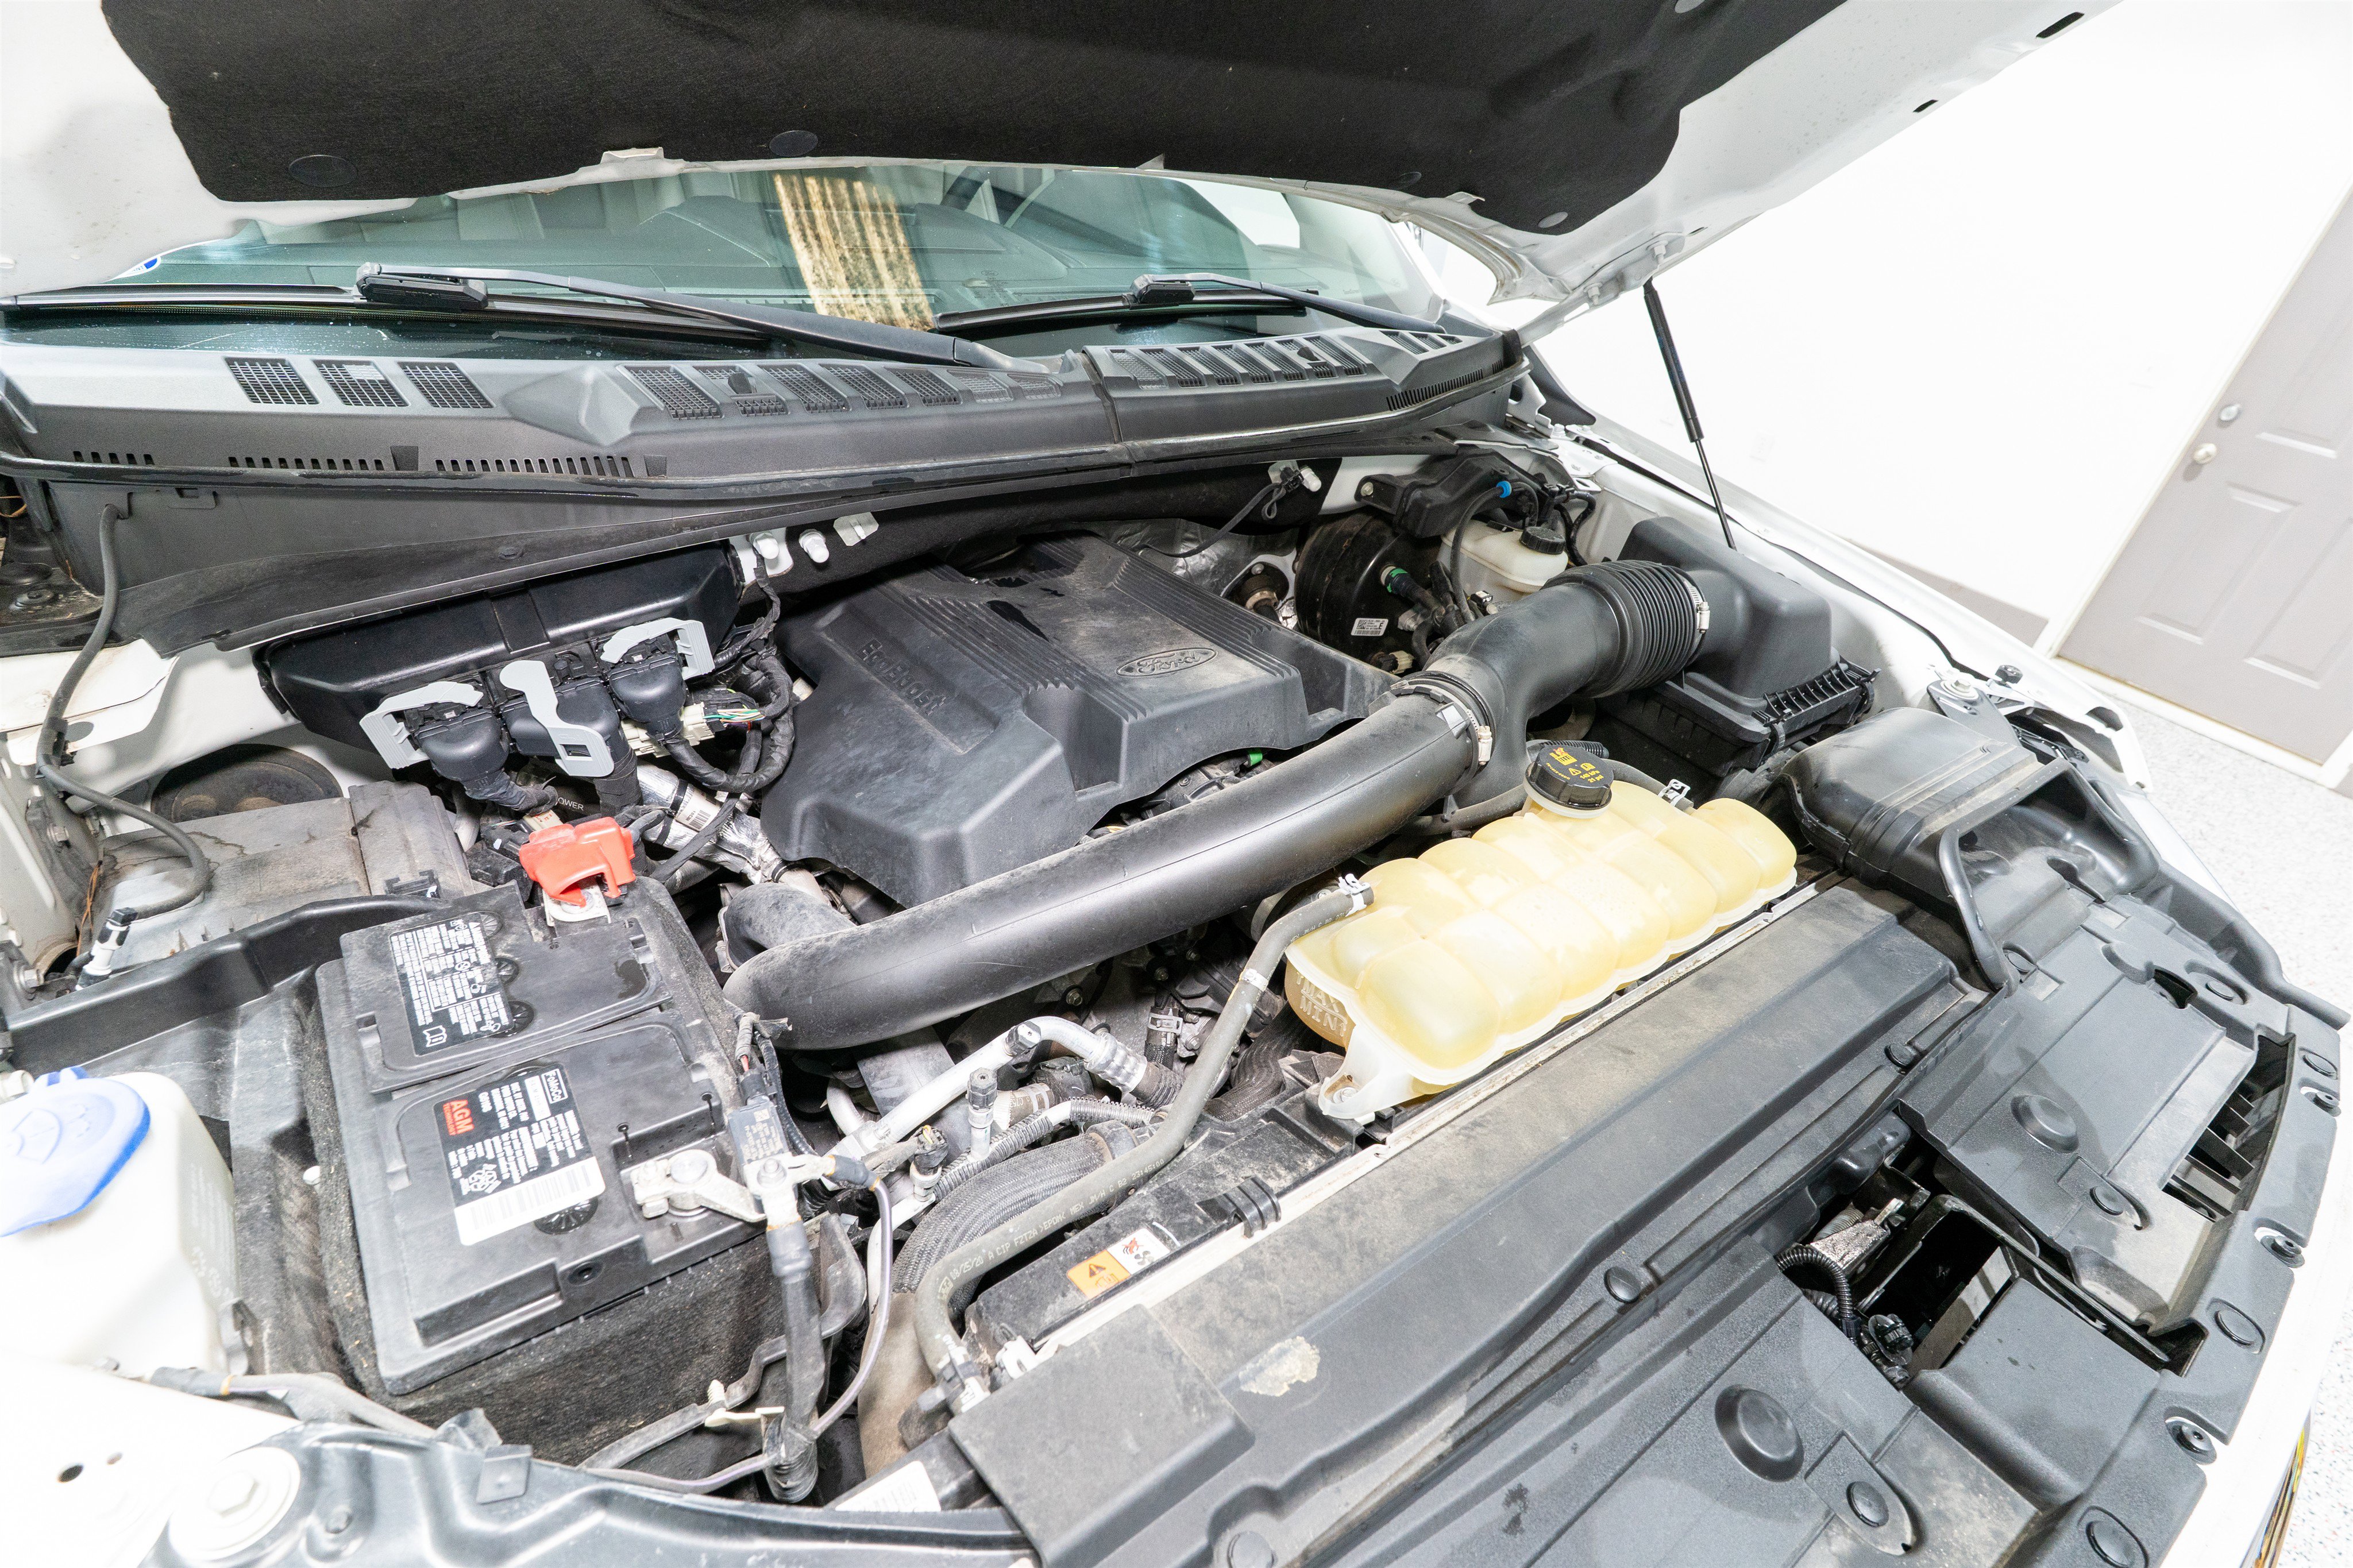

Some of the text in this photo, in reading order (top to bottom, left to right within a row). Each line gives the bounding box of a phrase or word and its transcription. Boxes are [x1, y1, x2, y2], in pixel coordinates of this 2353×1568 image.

[855, 638, 947, 716] EcoBoost
[1136, 651, 1201, 674] Ford
[558, 797, 584, 811] OWER
[1299, 995, 1338, 1031] MIN
[1302, 978, 1339, 1013] MAX
[544, 1071, 564, 1101] FoMoCo
[442, 1102, 457, 1137] TECHNOLOGY
[449, 1097, 475, 1134] AGM
[988, 1250, 994, 1260] A
[1070, 1202, 1085, 1215] MEX
[1132, 1158, 1165, 1180] 23:45:00
